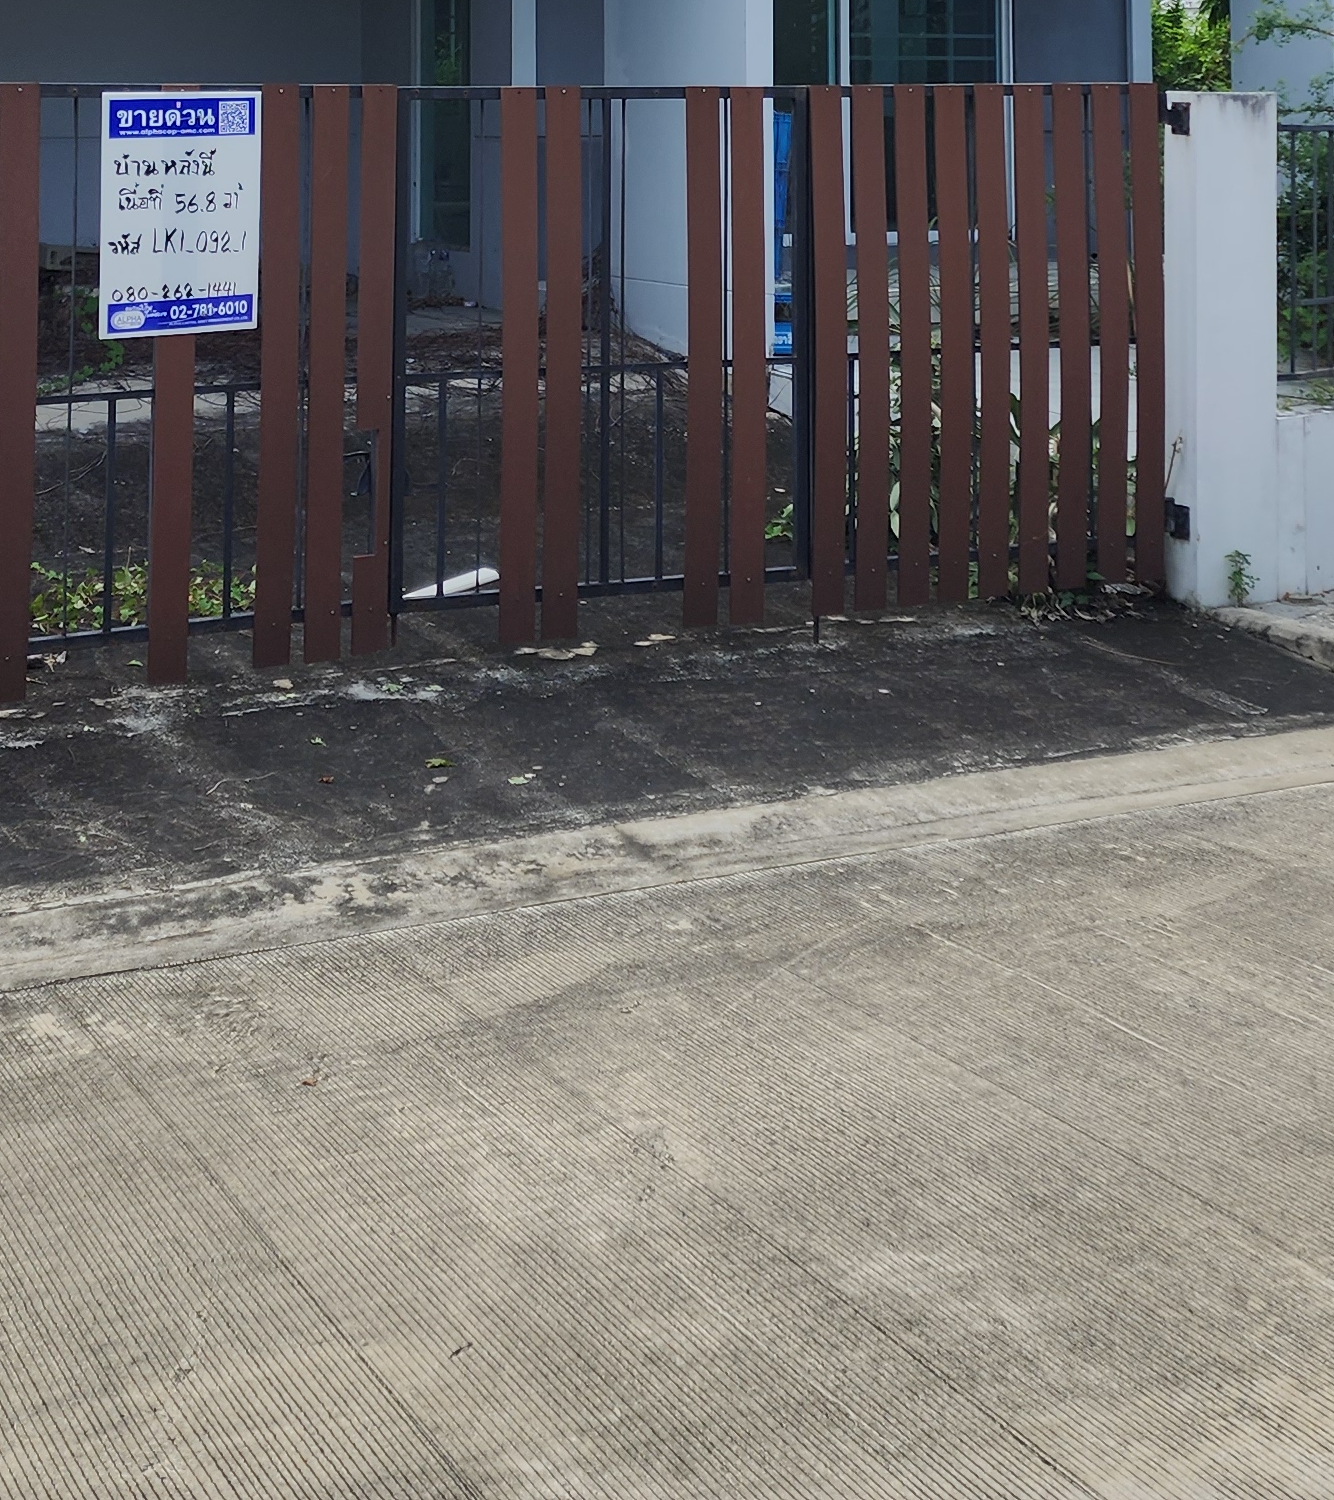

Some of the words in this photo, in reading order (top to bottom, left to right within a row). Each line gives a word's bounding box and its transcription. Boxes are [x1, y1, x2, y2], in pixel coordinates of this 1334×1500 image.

[116, 101, 216, 127] ขายด่วน
[174, 191, 217, 214] 56.8
[107, 233, 143, 255] รหัส
[169, 299, 248, 320] 02-781-6010
